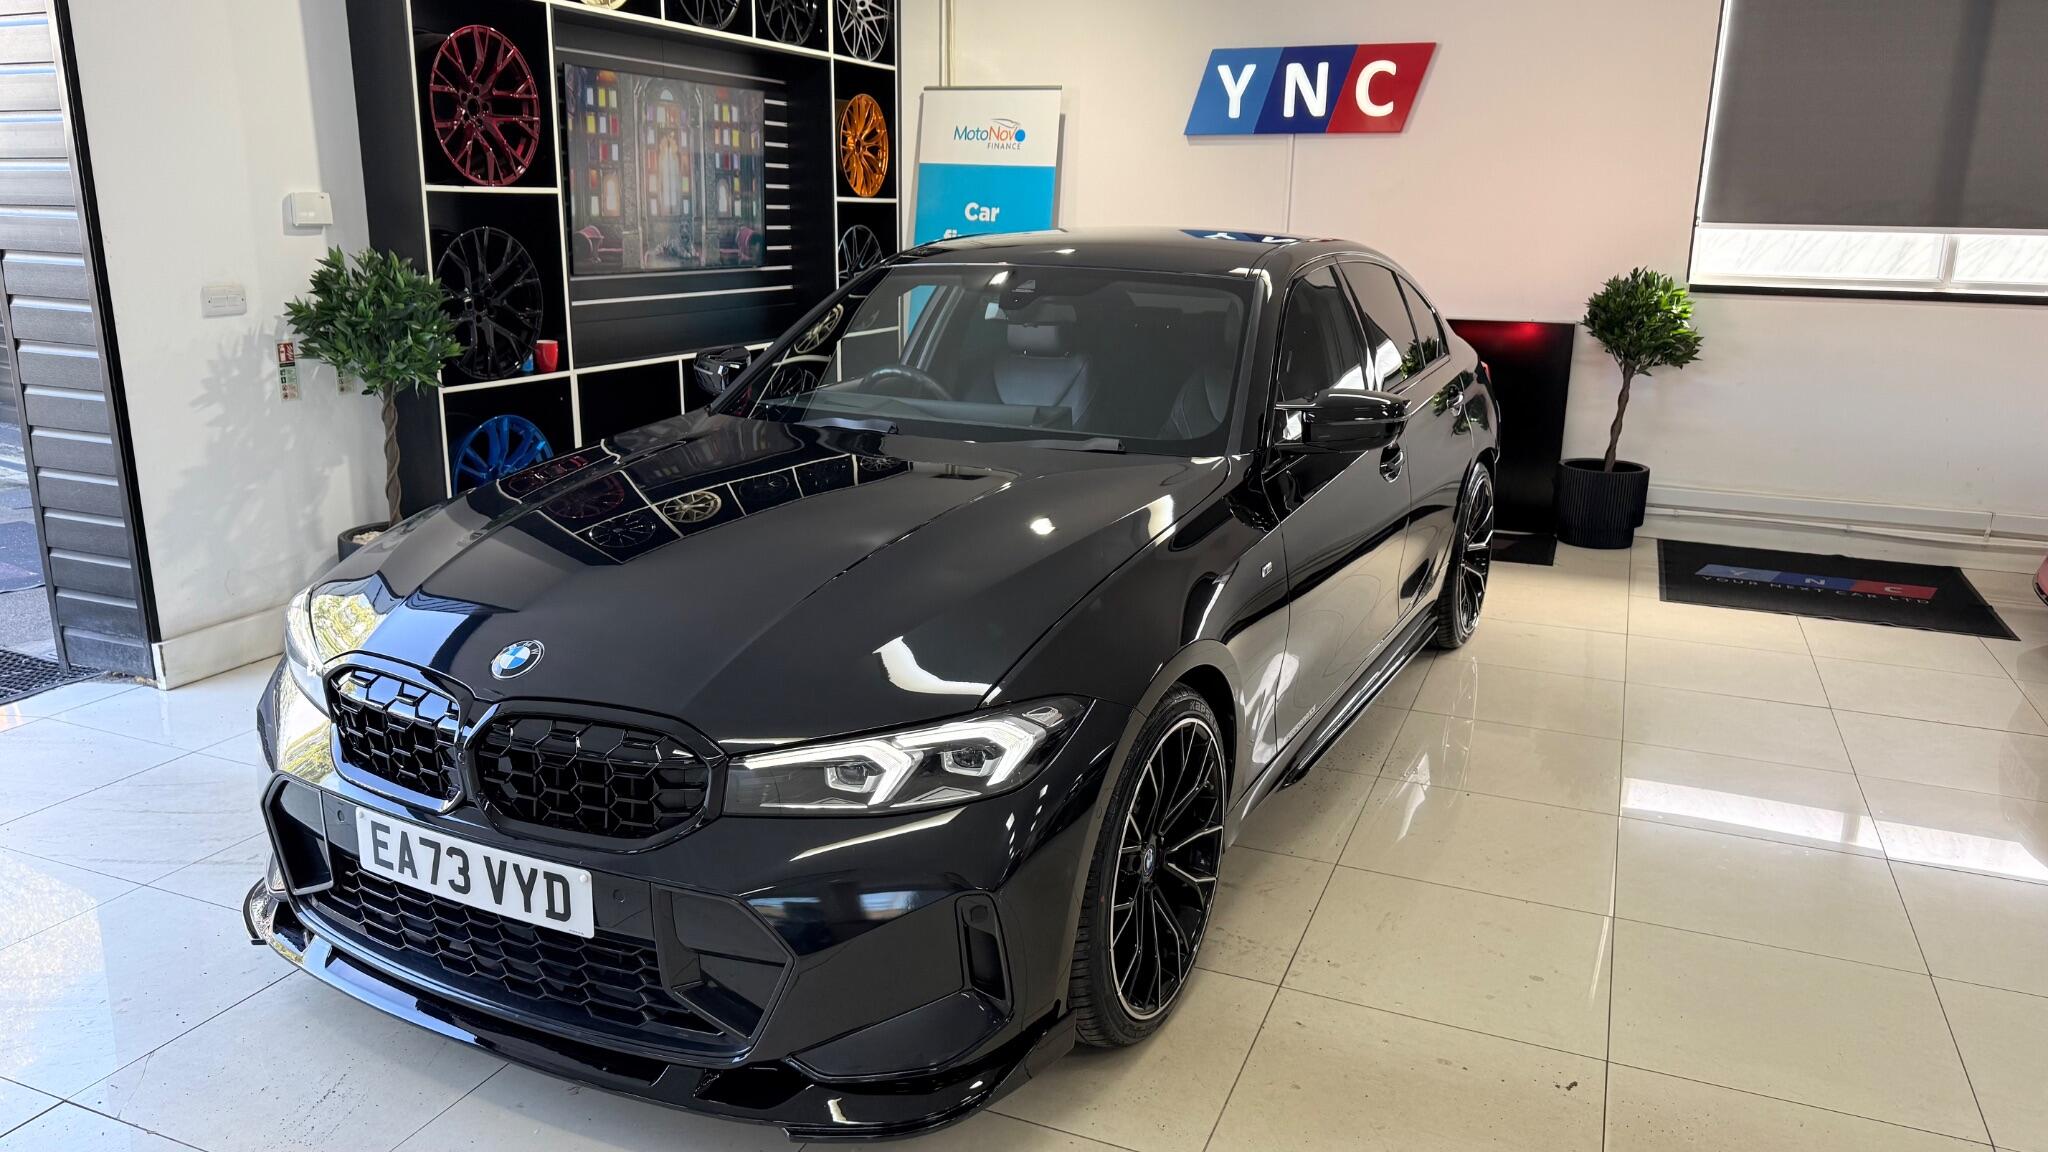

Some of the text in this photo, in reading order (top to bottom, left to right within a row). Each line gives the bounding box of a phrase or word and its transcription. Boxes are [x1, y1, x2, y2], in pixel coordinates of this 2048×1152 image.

[1217, 59, 1397, 118] YNC
[954, 126, 1026, 142] MotoNovo
[987, 142, 1021, 150] FINANCE
[964, 202, 1000, 222] Car
[1702, 576, 1930, 604] YOUR NEXT CAR LTD
[371, 821, 572, 922] EA73 VYD
